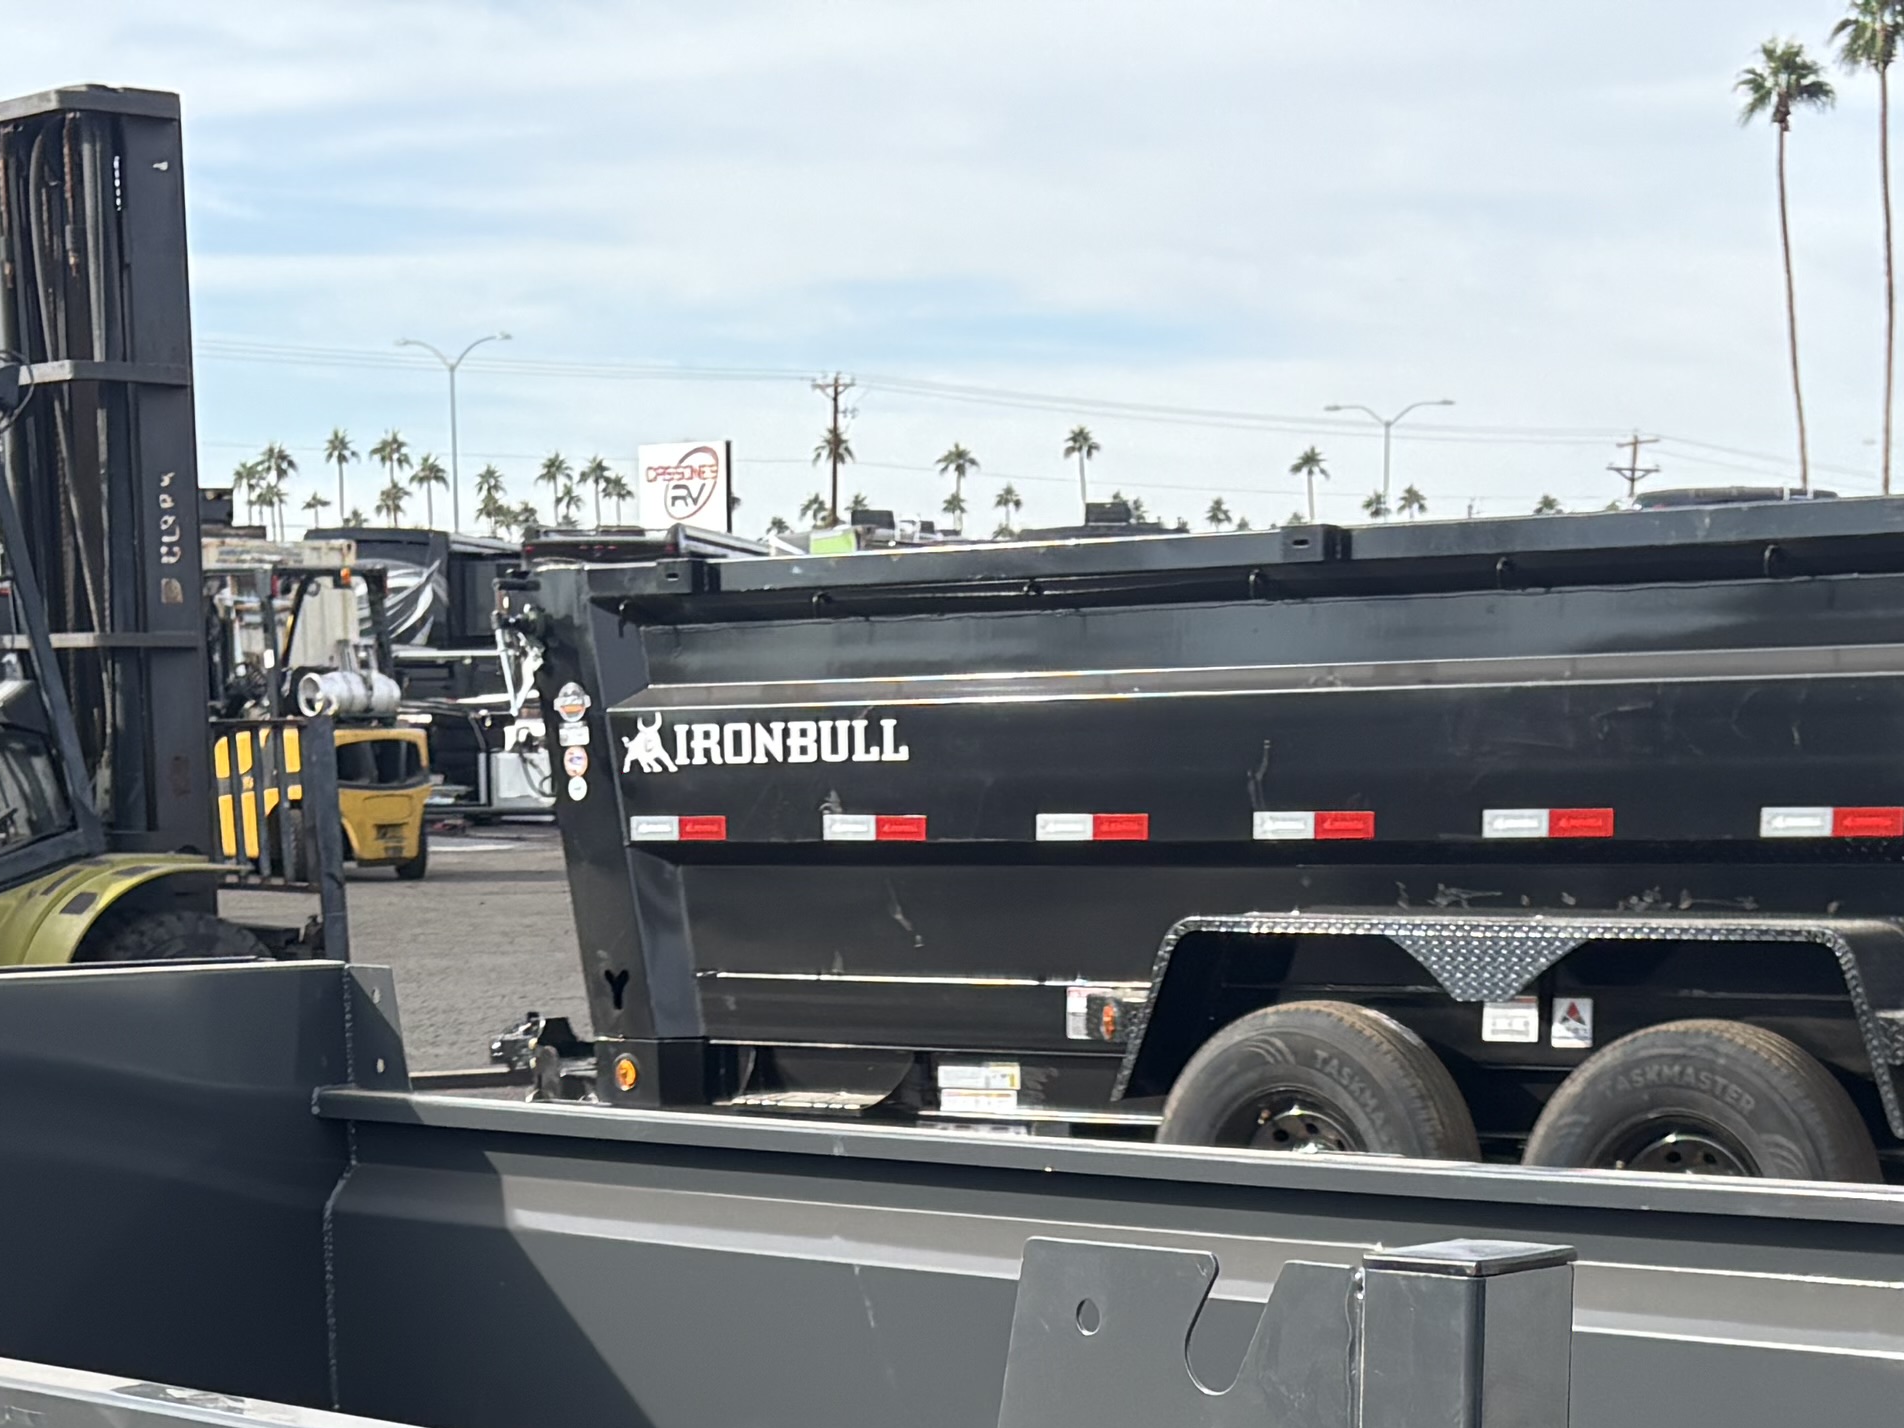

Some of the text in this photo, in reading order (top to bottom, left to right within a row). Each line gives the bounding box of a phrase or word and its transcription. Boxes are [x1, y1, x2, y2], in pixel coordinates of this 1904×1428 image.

[671, 483, 706, 507] RV
[674, 718, 910, 765] IRONBULL
[1603, 1064, 1756, 1115] TASKMASTER
